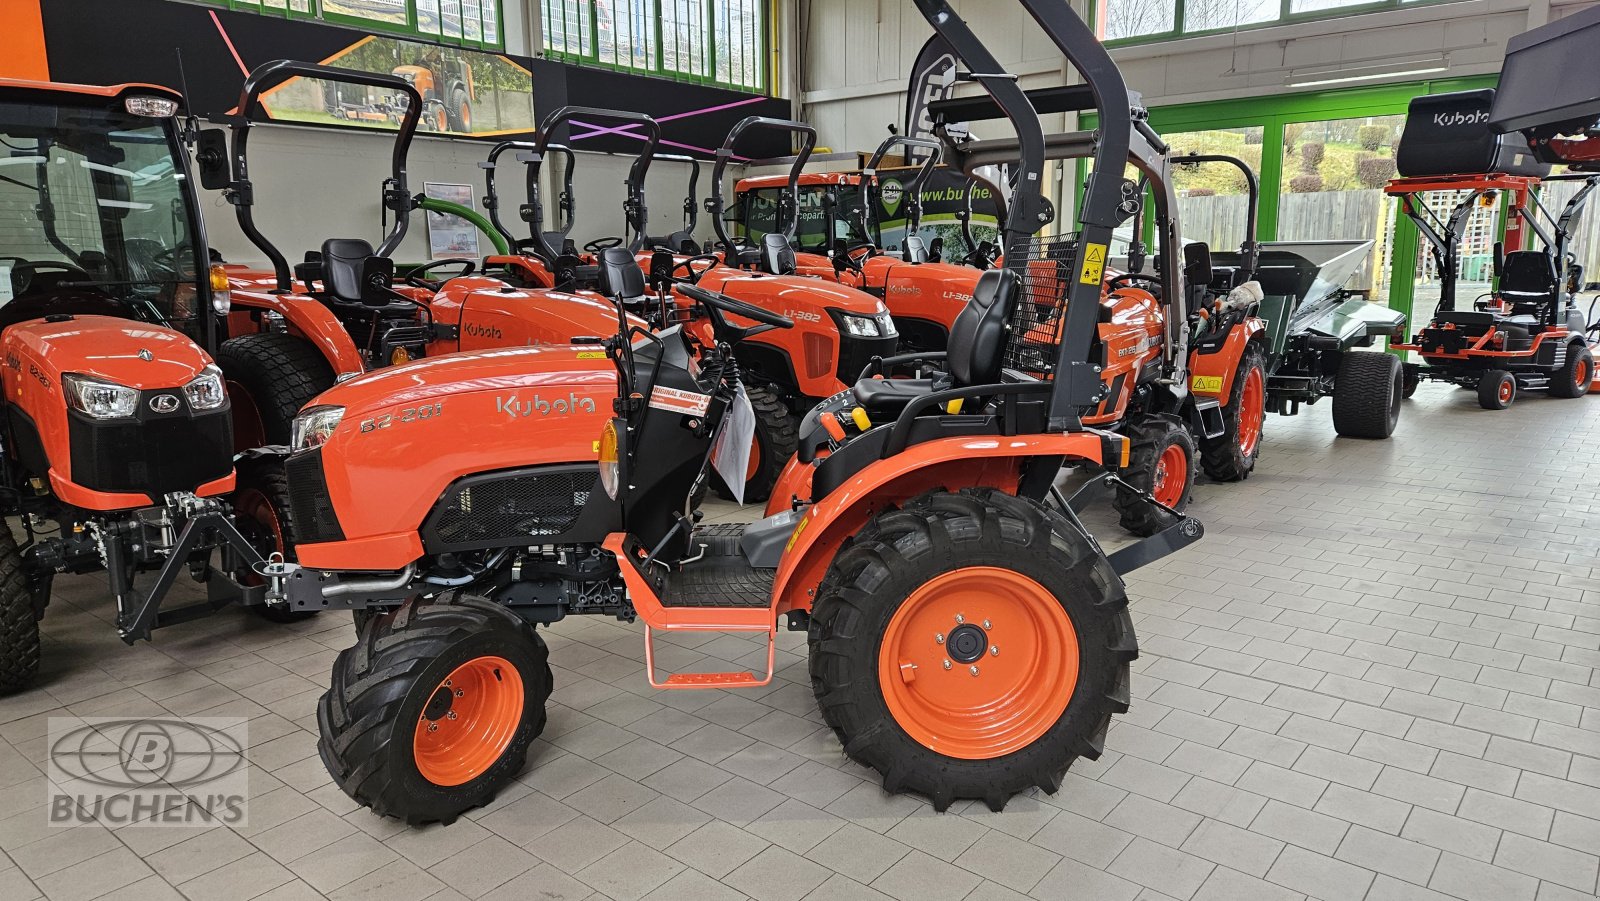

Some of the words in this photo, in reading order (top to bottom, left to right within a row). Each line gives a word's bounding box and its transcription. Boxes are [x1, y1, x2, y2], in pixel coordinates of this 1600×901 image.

[464, 322, 502, 339] Kubota
[360, 403, 442, 433] B2-201
[496, 392, 596, 418] Kubota
